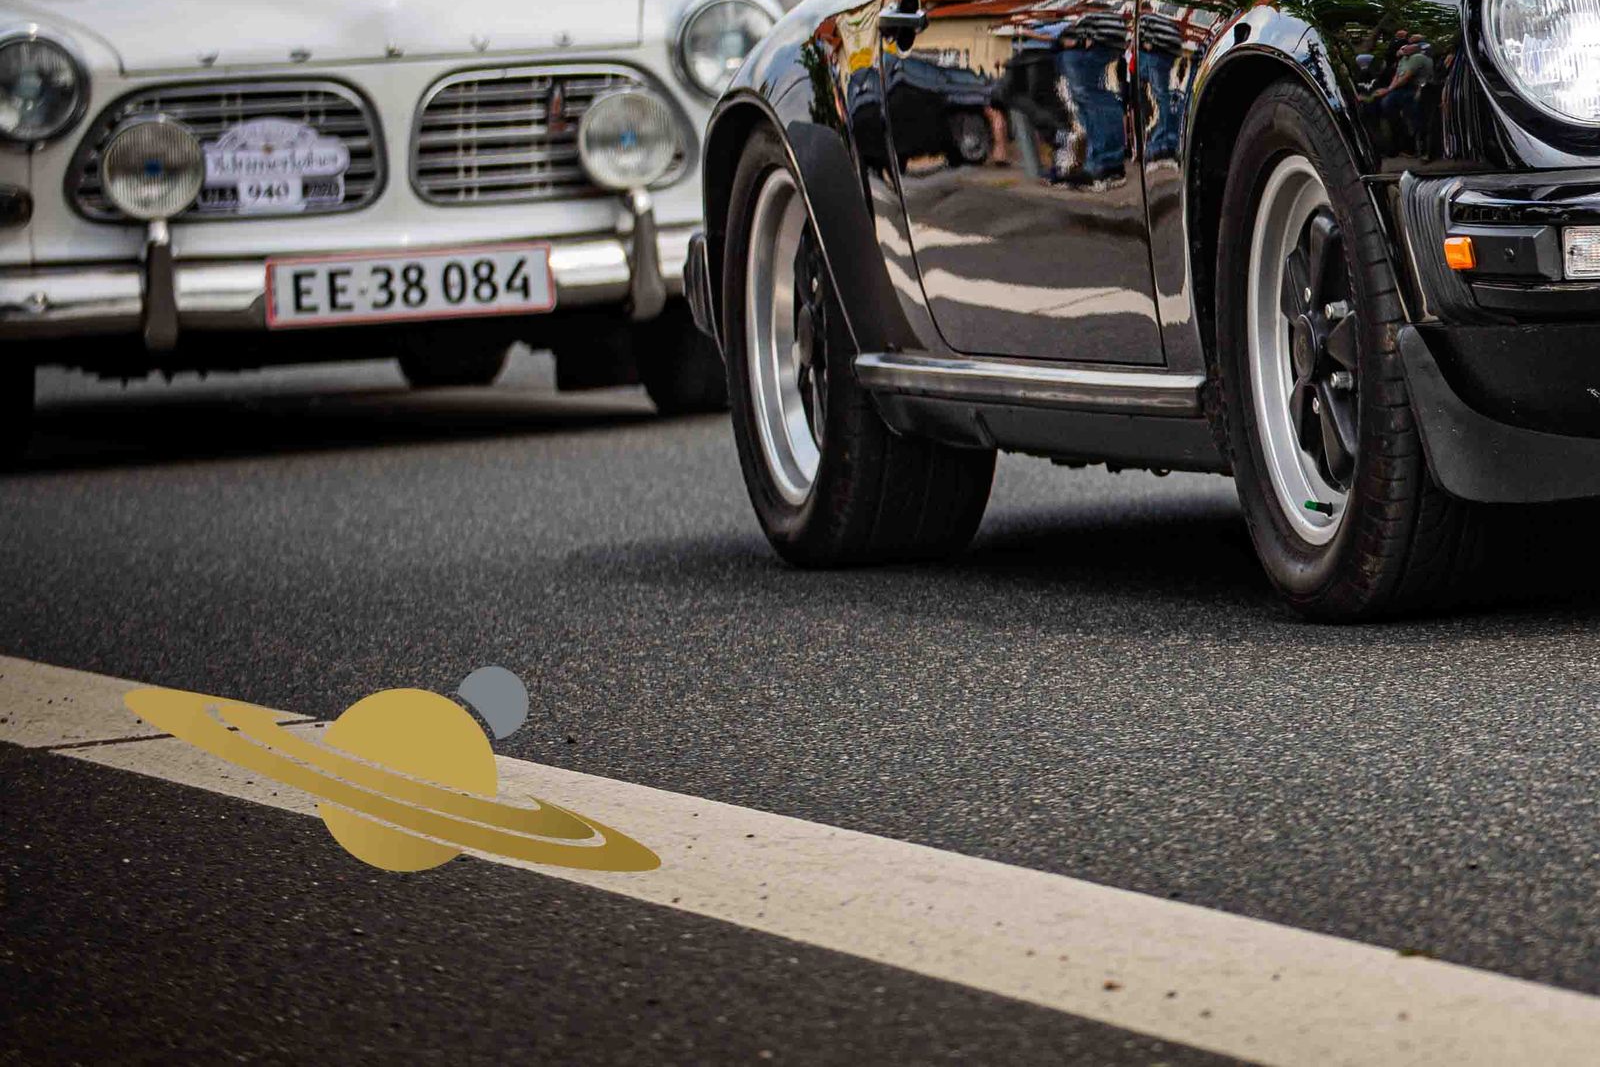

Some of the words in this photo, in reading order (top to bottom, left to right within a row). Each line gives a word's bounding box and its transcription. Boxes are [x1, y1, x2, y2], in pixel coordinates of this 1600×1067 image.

[293, 269, 353, 314] EE
[371, 262, 428, 310] 38
[442, 256, 531, 304] 084
